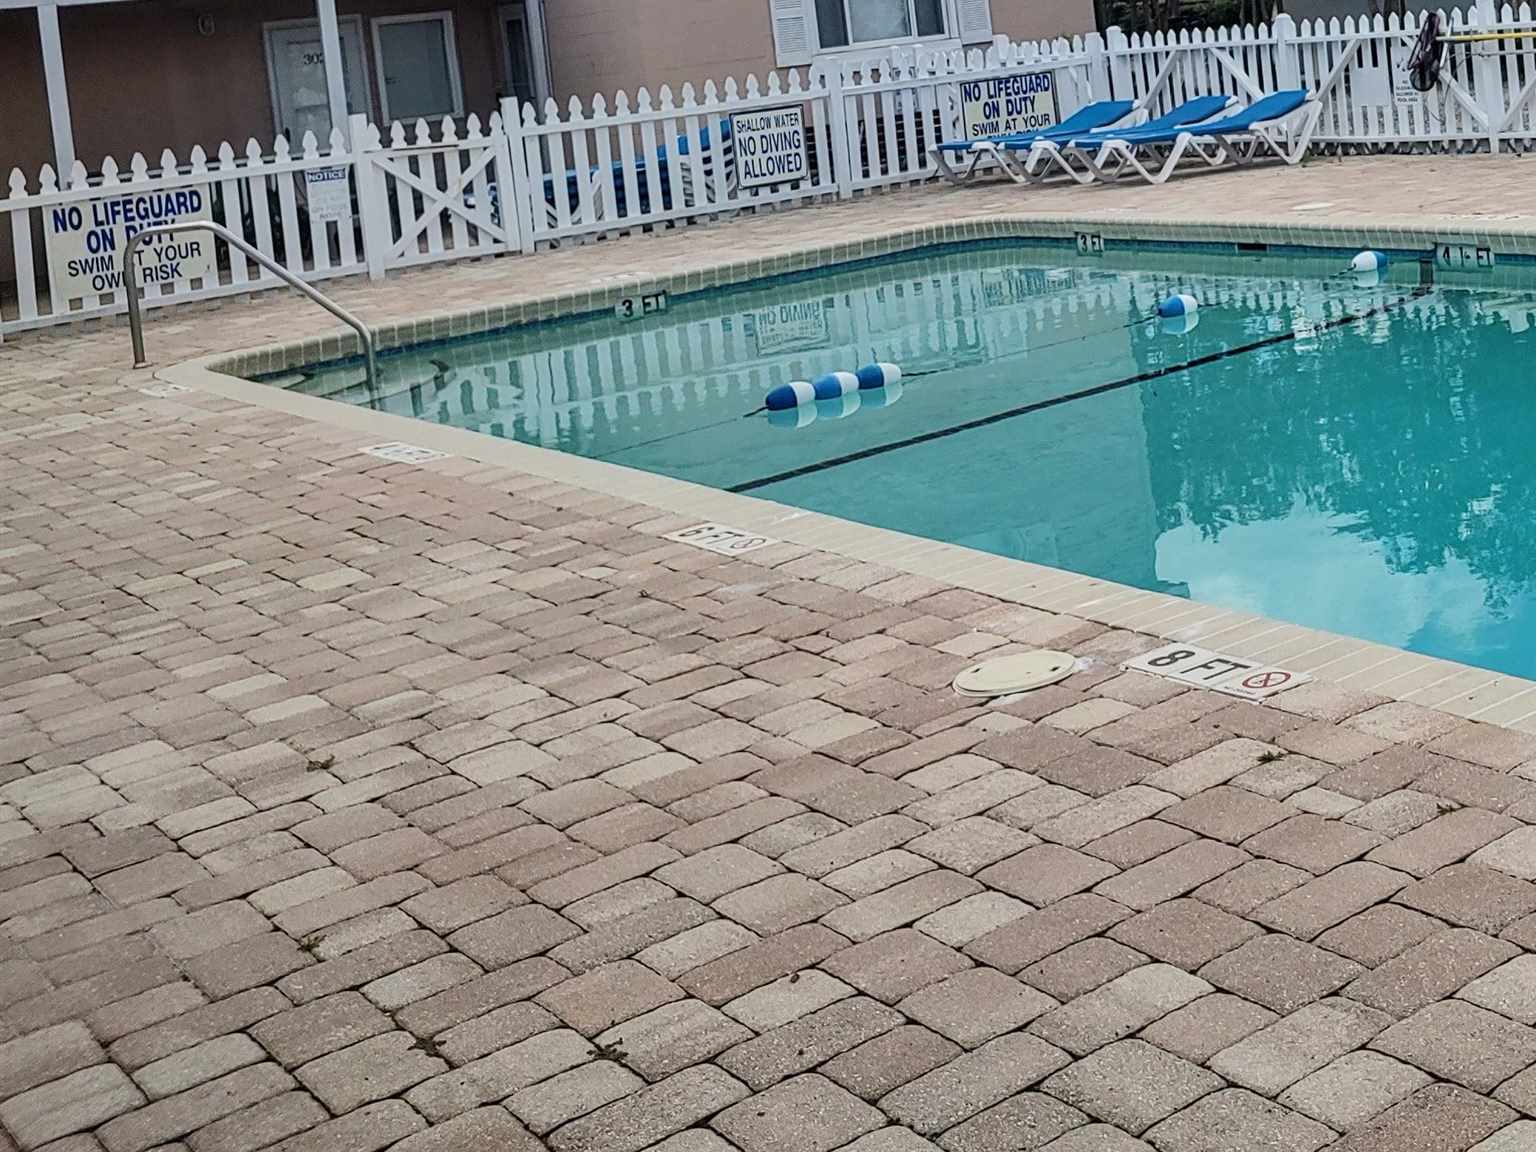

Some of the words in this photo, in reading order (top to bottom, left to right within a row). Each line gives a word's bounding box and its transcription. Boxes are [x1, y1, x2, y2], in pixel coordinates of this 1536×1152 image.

[964, 84, 981, 102] NO
[987, 74, 1050, 99] LIFEGUARD
[983, 101, 1000, 120] ON
[1006, 95, 1035, 116] DUTY
[736, 116, 771, 133] SHALLOW
[774, 112, 799, 128] WATER
[972, 120, 999, 136] SWIM
[1005, 118, 1017, 131] AT
[1022, 113, 1051, 128] YOUR
[739, 136, 756, 157] NO
[760, 130, 801, 154] DIVING
[308, 170, 345, 182] NOTICE
[744, 152, 802, 179] ALLOWED
[53, 206, 82, 233] NO
[92, 189, 202, 227] LIFEGUARD
[86, 228, 116, 254] ON
[67, 255, 114, 277] SWIM
[154, 241, 202, 263] YOUR
[92, 271, 127, 291] OW
[142, 262, 183, 283] RISK
[622, 299, 634, 316] 3
[1148, 650, 1195, 666] 8
[1180, 658, 1251, 680] FT
